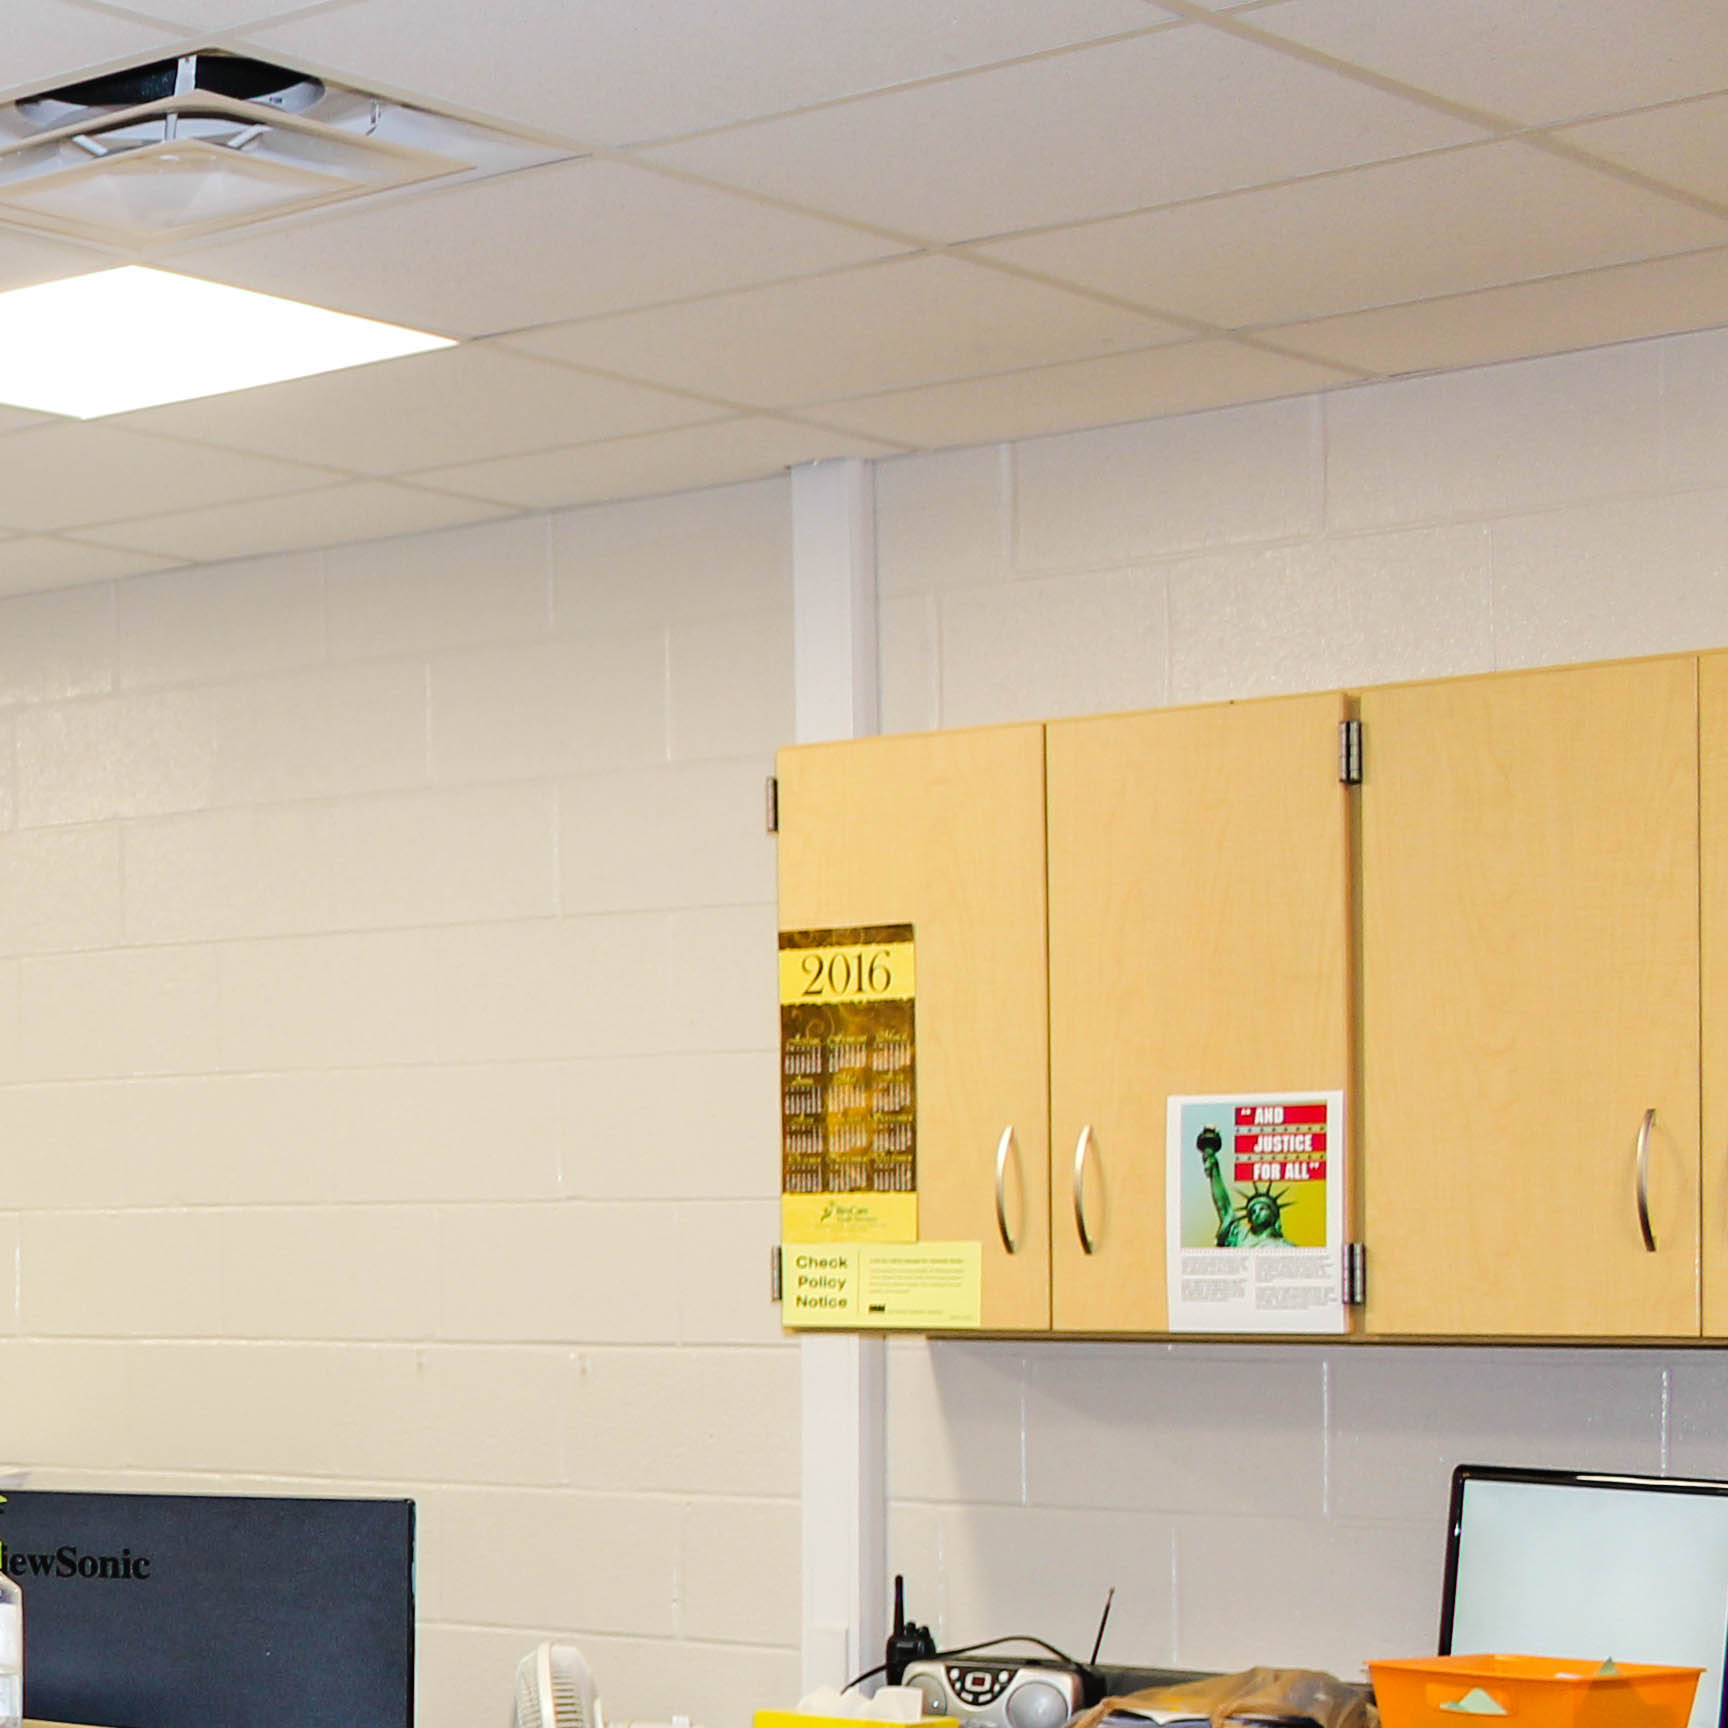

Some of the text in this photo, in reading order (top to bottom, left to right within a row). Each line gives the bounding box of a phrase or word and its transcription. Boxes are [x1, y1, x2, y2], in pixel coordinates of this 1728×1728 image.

[802, 950, 891, 996] 2016
[1254, 1134, 1312, 1152] JUSTICE
[1253, 1163, 1281, 1180] FOR
[796, 1255, 848, 1269] Check
[798, 1276, 846, 1291] Policy
[796, 1295, 848, 1309] Notice
[7, 1546, 151, 1579] ewSonic
